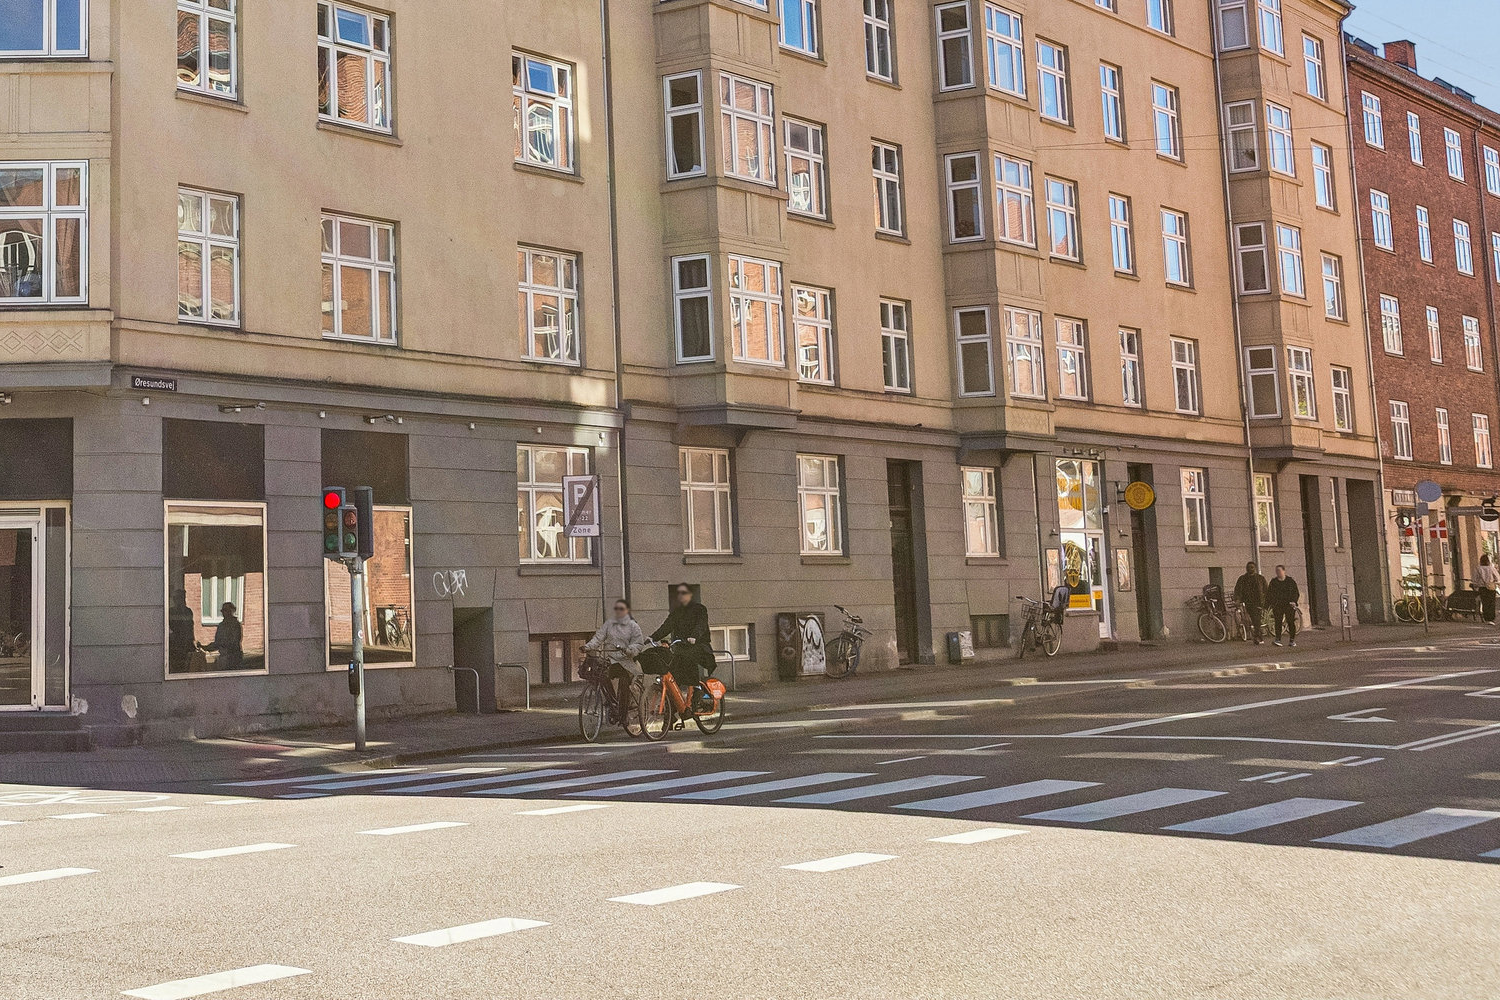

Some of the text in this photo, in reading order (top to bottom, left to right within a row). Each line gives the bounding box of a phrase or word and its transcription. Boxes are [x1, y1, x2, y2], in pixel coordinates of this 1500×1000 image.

[135, 378, 175, 391] Øresundsvej
[574, 484, 587, 505] P
[573, 526, 592, 534] Zone
